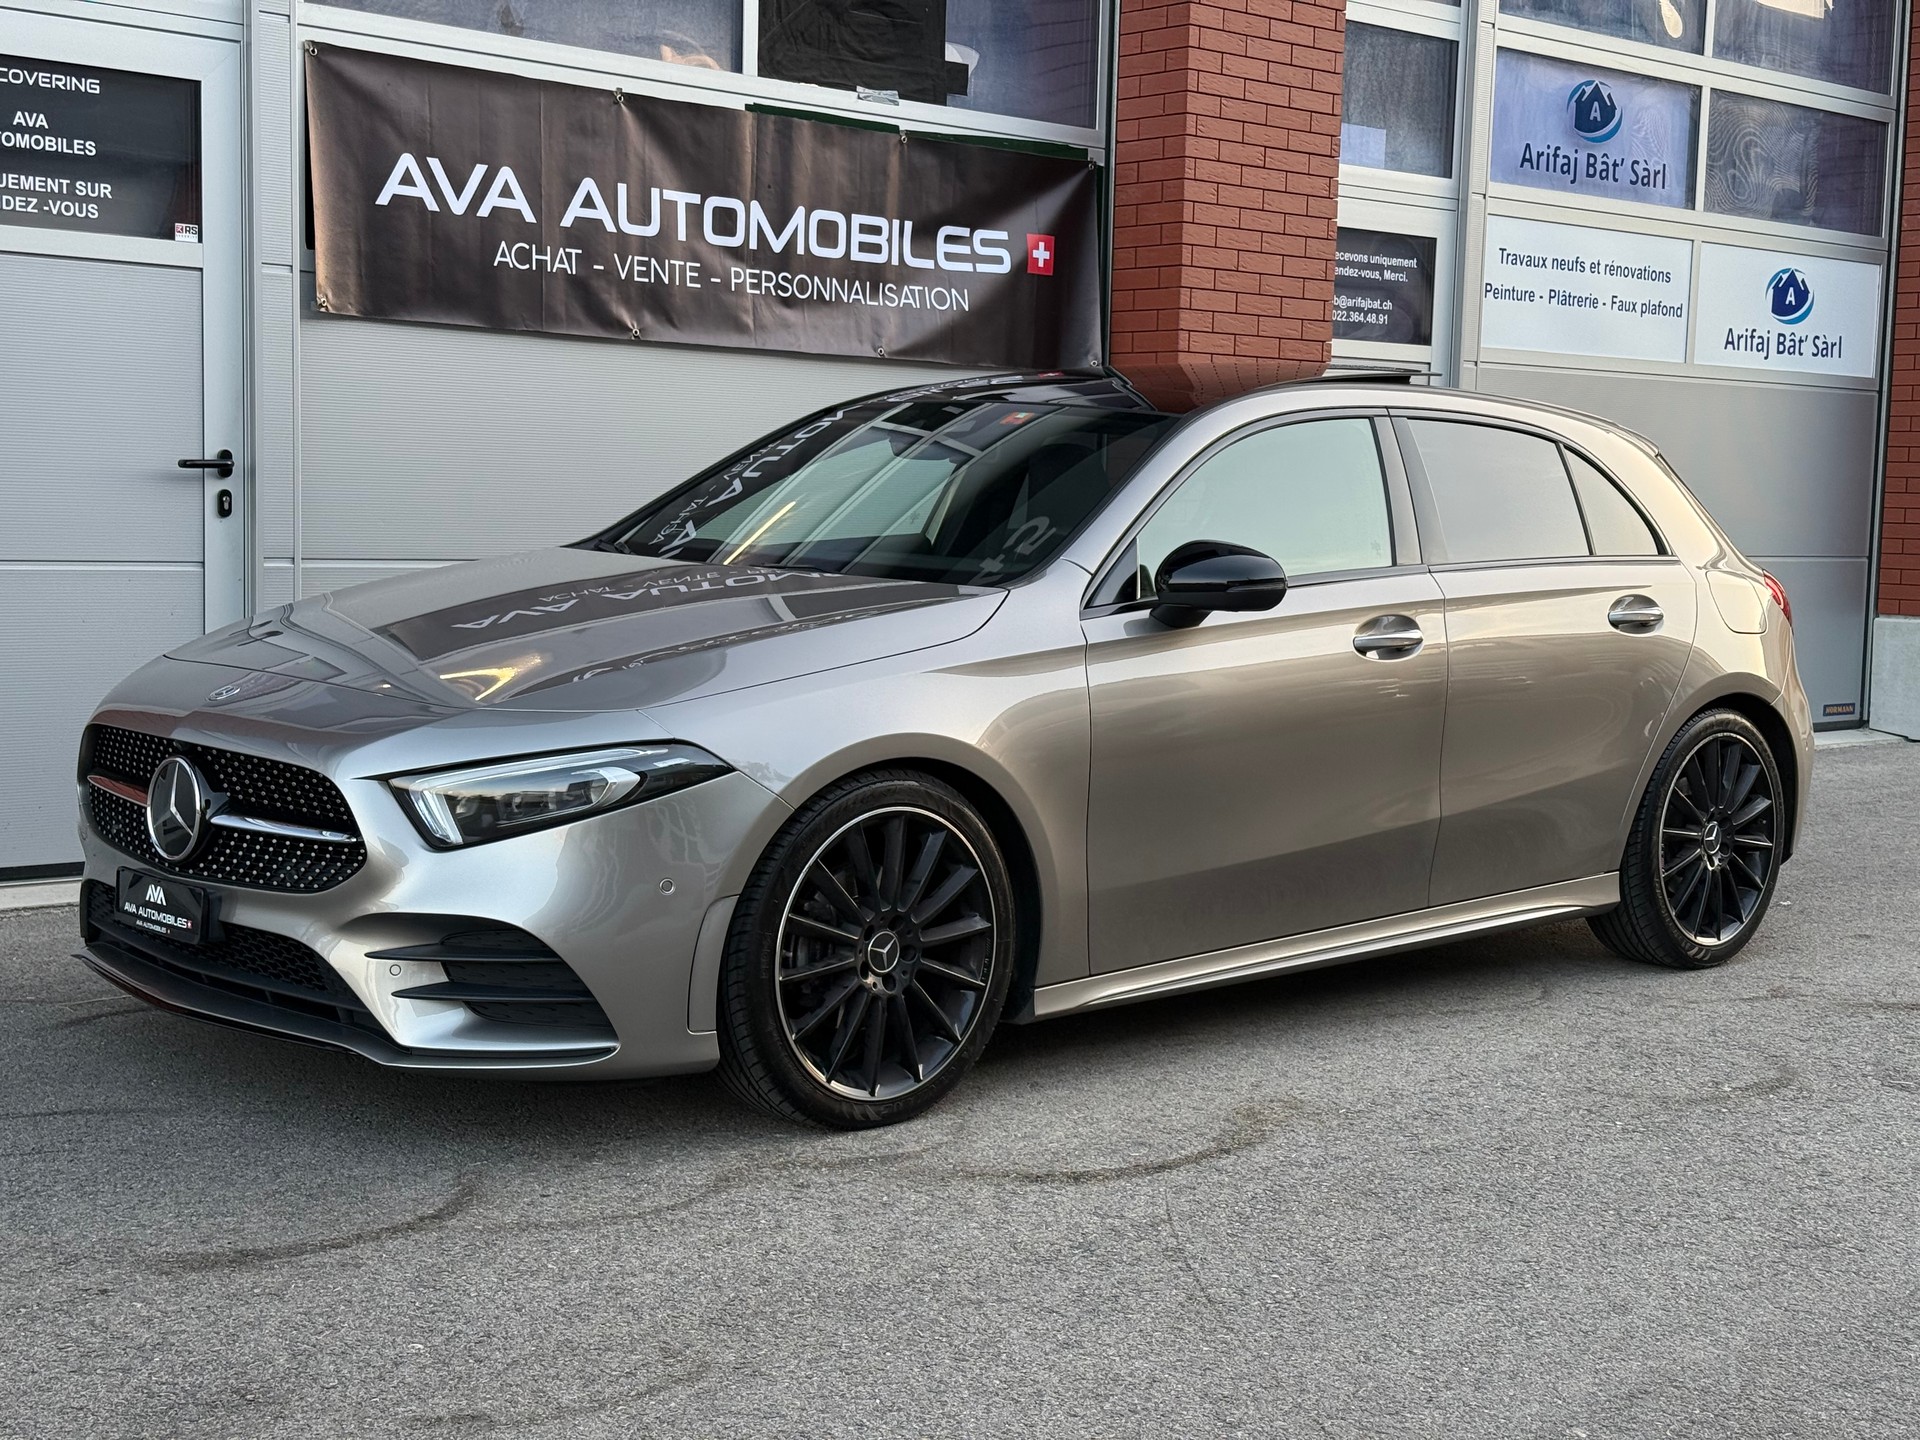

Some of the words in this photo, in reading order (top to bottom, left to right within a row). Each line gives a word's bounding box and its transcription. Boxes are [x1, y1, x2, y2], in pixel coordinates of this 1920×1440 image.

[13, 111, 48, 129] AVA
[0, 131, 97, 156] OMOBILES
[1520, 142, 1578, 185] Arifaj
[1629, 159, 1667, 190] Sàrl
[75, 181, 112, 199] SUR
[0, 195, 38, 213] DEZ
[375, 152, 537, 223] AVA
[559, 177, 1012, 275] AUTOMOBILES
[1370, 254, 1417, 268] uniquement
[1499, 247, 1548, 269] Travaux
[1551, 256, 1586, 273] neufs
[1589, 259, 1601, 275] et
[1604, 260, 1671, 283] rénovations
[493, 240, 583, 275] ACHAT
[614, 253, 701, 288] VENTE
[730, 267, 969, 312] PERSONNALISATION
[1384, 269, 1408, 282] Merci.
[1484, 282, 1535, 303] Peinture
[1548, 289, 1599, 309] Plâtrerie
[1610, 295, 1637, 313] Faux
[1640, 299, 1683, 318] plafond
[1332, 310, 1388, 324] 022.364.48.91
[1724, 327, 1770, 360] Arifaj
[1811, 334, 1842, 359] Sàrl
[124, 901, 137, 914] AVA
[138, 905, 188, 929] AUTOMOBILES
